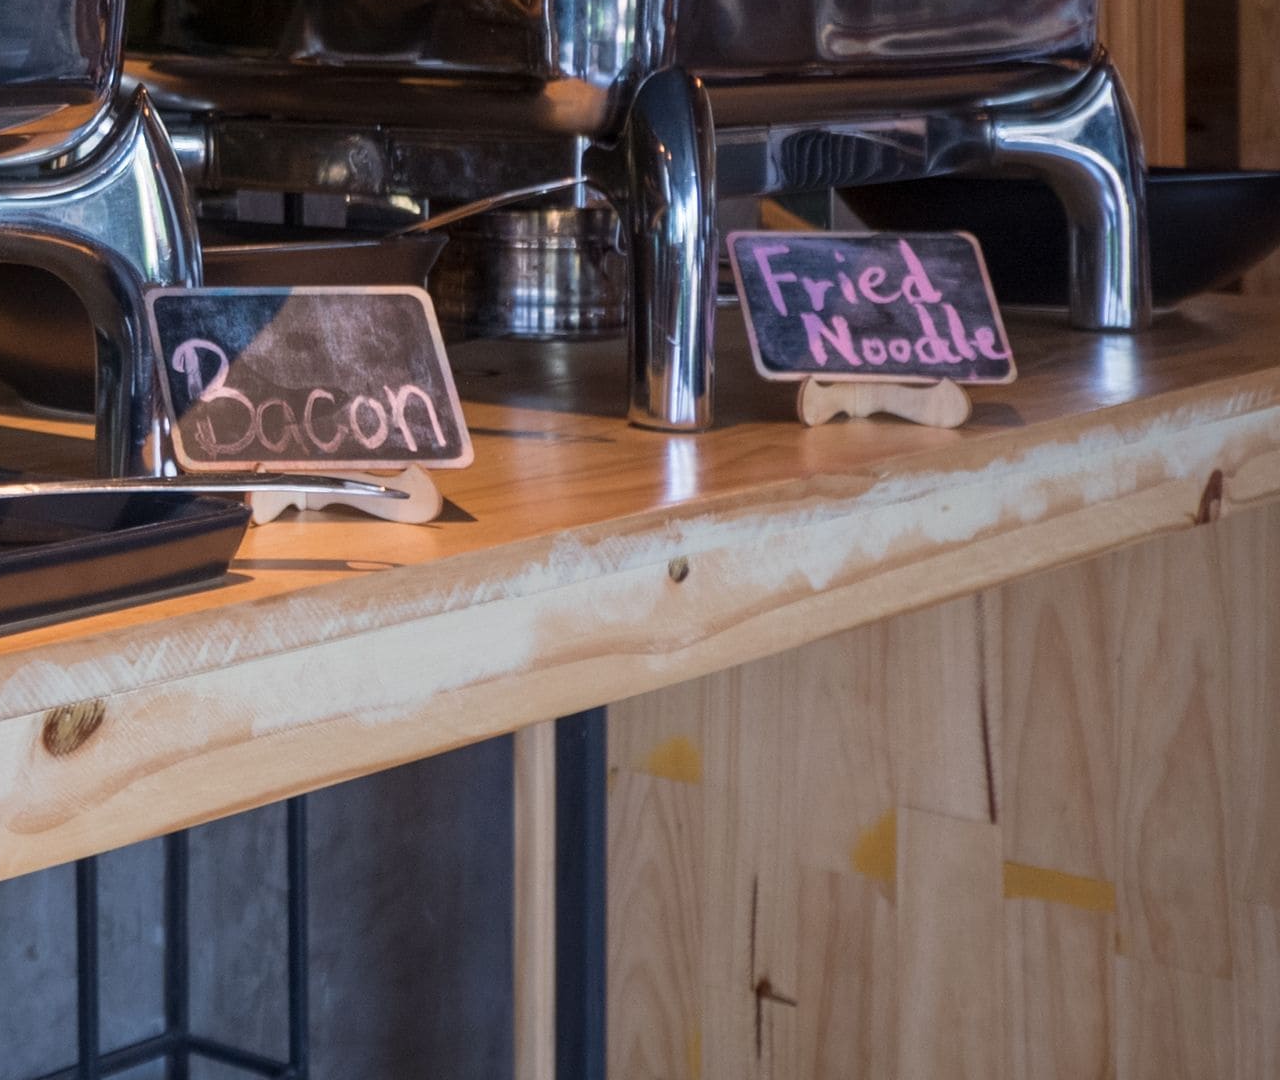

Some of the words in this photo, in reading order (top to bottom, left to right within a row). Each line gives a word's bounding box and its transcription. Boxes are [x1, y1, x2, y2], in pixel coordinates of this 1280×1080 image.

[752, 237, 942, 317] Fried
[800, 303, 1011, 368] Noodle
[171, 337, 447, 458] Bacon
